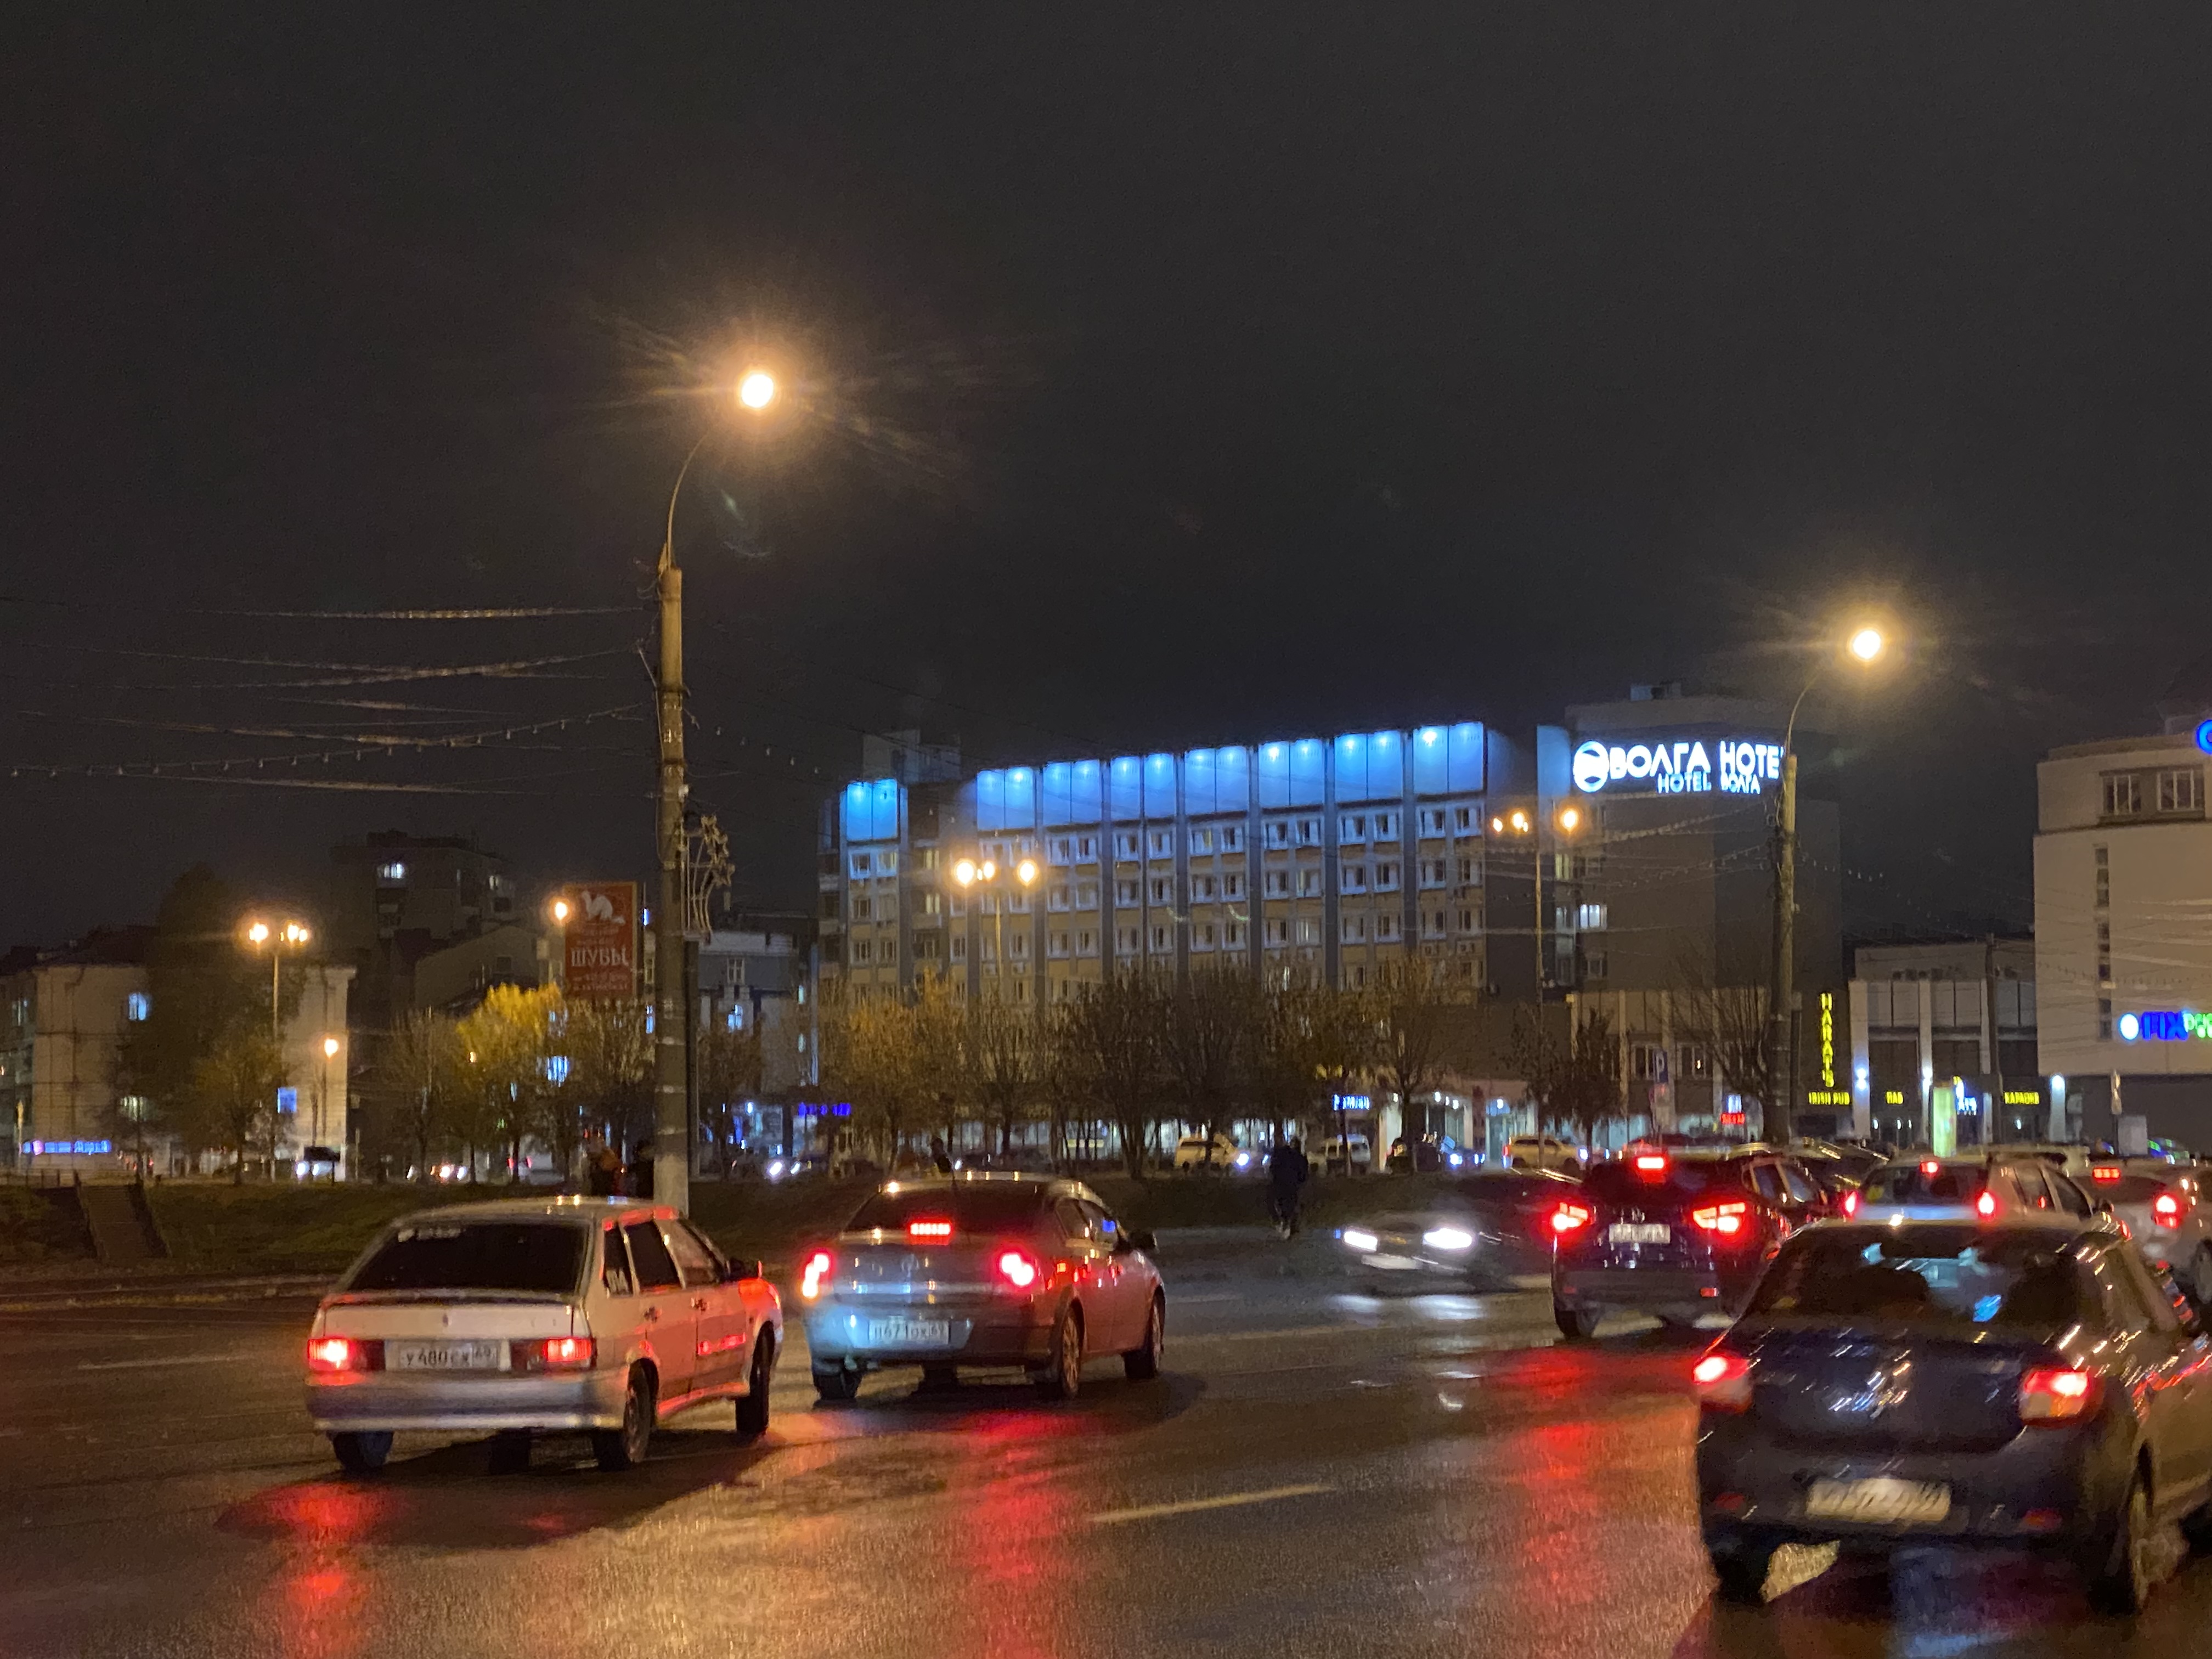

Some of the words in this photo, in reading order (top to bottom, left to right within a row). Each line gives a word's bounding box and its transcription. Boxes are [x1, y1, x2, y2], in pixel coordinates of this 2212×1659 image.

[1609, 741, 1711, 780] ВОЛГА
[1657, 772, 1712, 794] HOTEL
[571, 945, 629, 967] ШУБЫ
